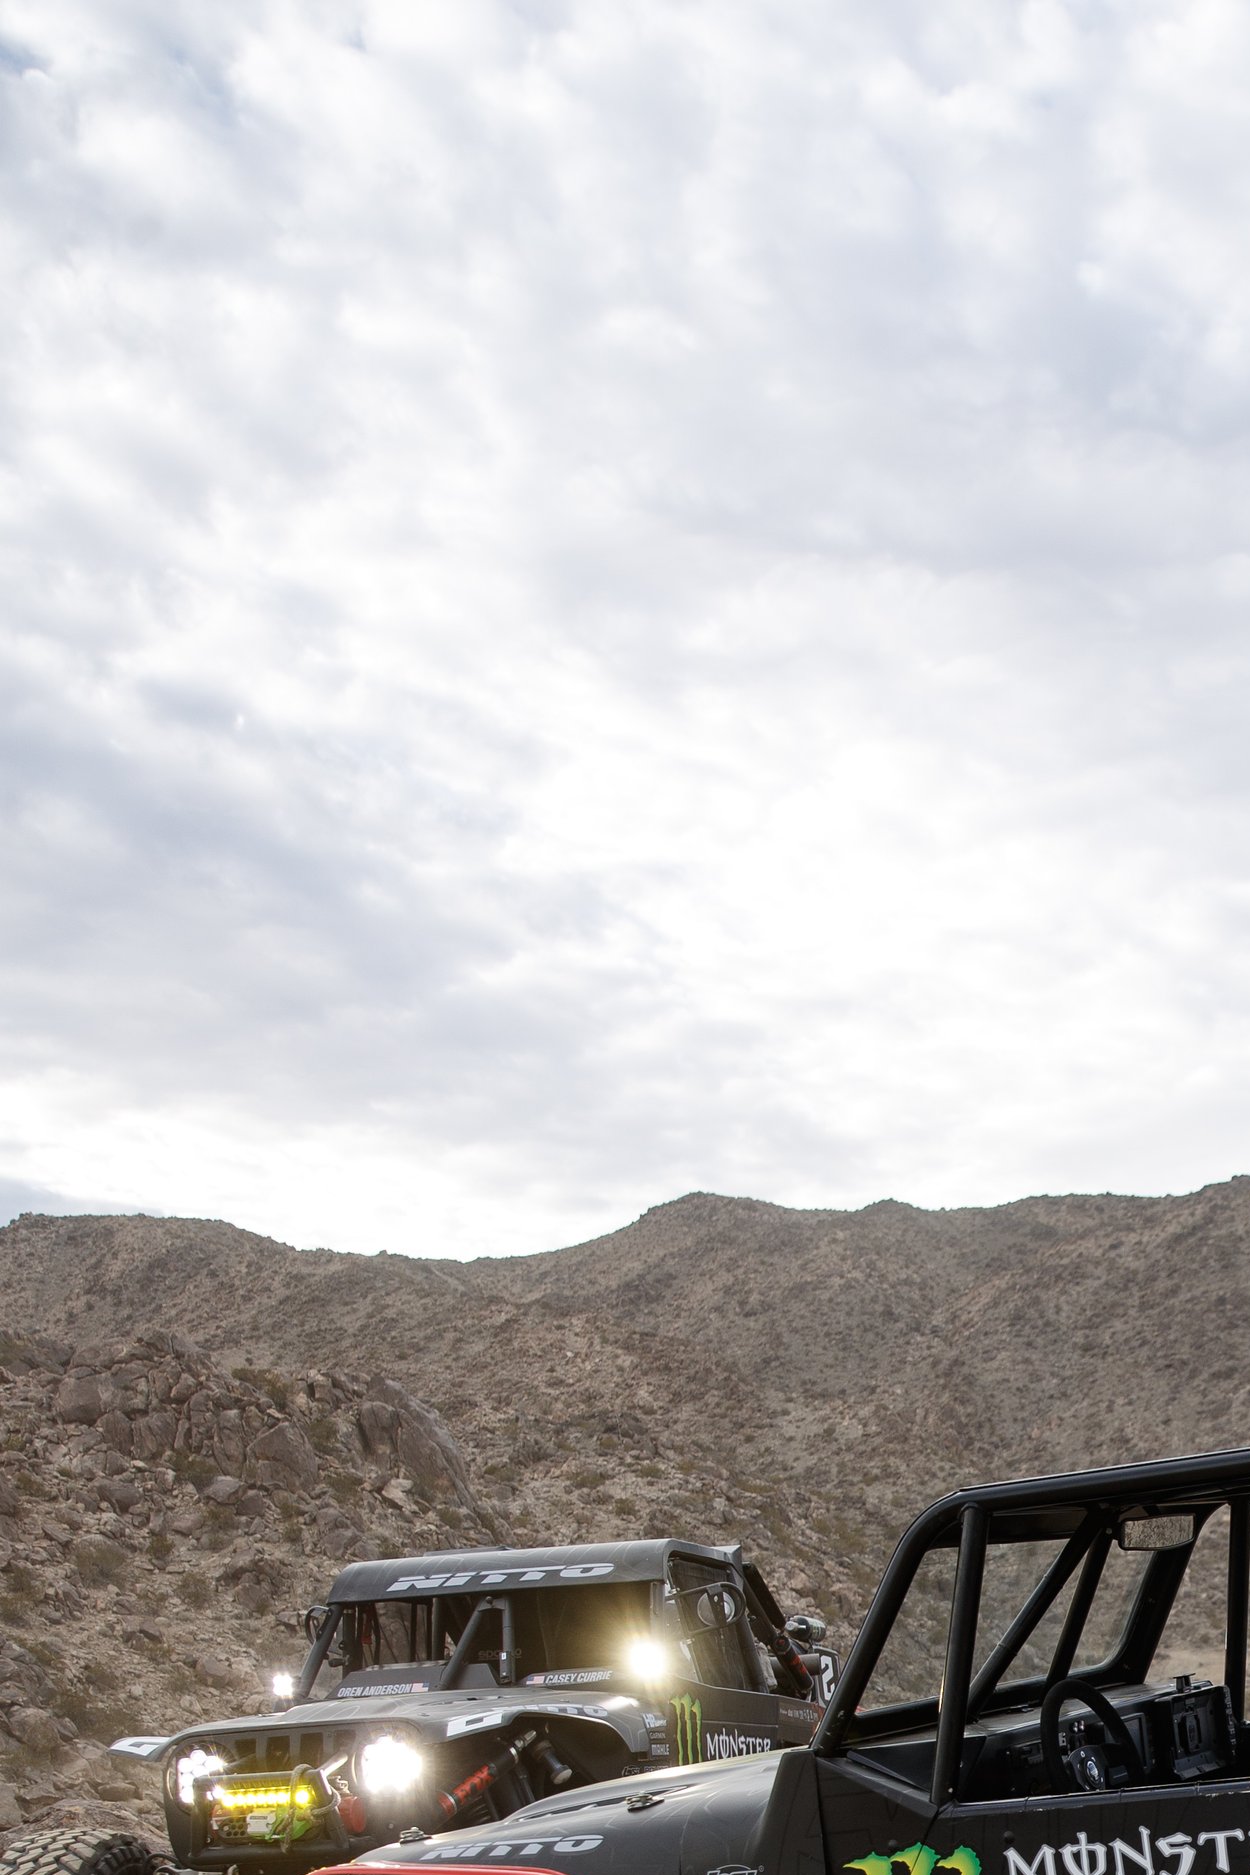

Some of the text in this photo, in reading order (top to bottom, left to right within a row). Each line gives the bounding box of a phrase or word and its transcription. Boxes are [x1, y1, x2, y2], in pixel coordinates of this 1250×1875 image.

[386, 1563, 615, 1592] NITTO
[545, 1670, 613, 1684] CASEY CURRIE
[337, 1683, 412, 1697] OREN ANDERSON
[420, 1835, 605, 1861] NITTO
